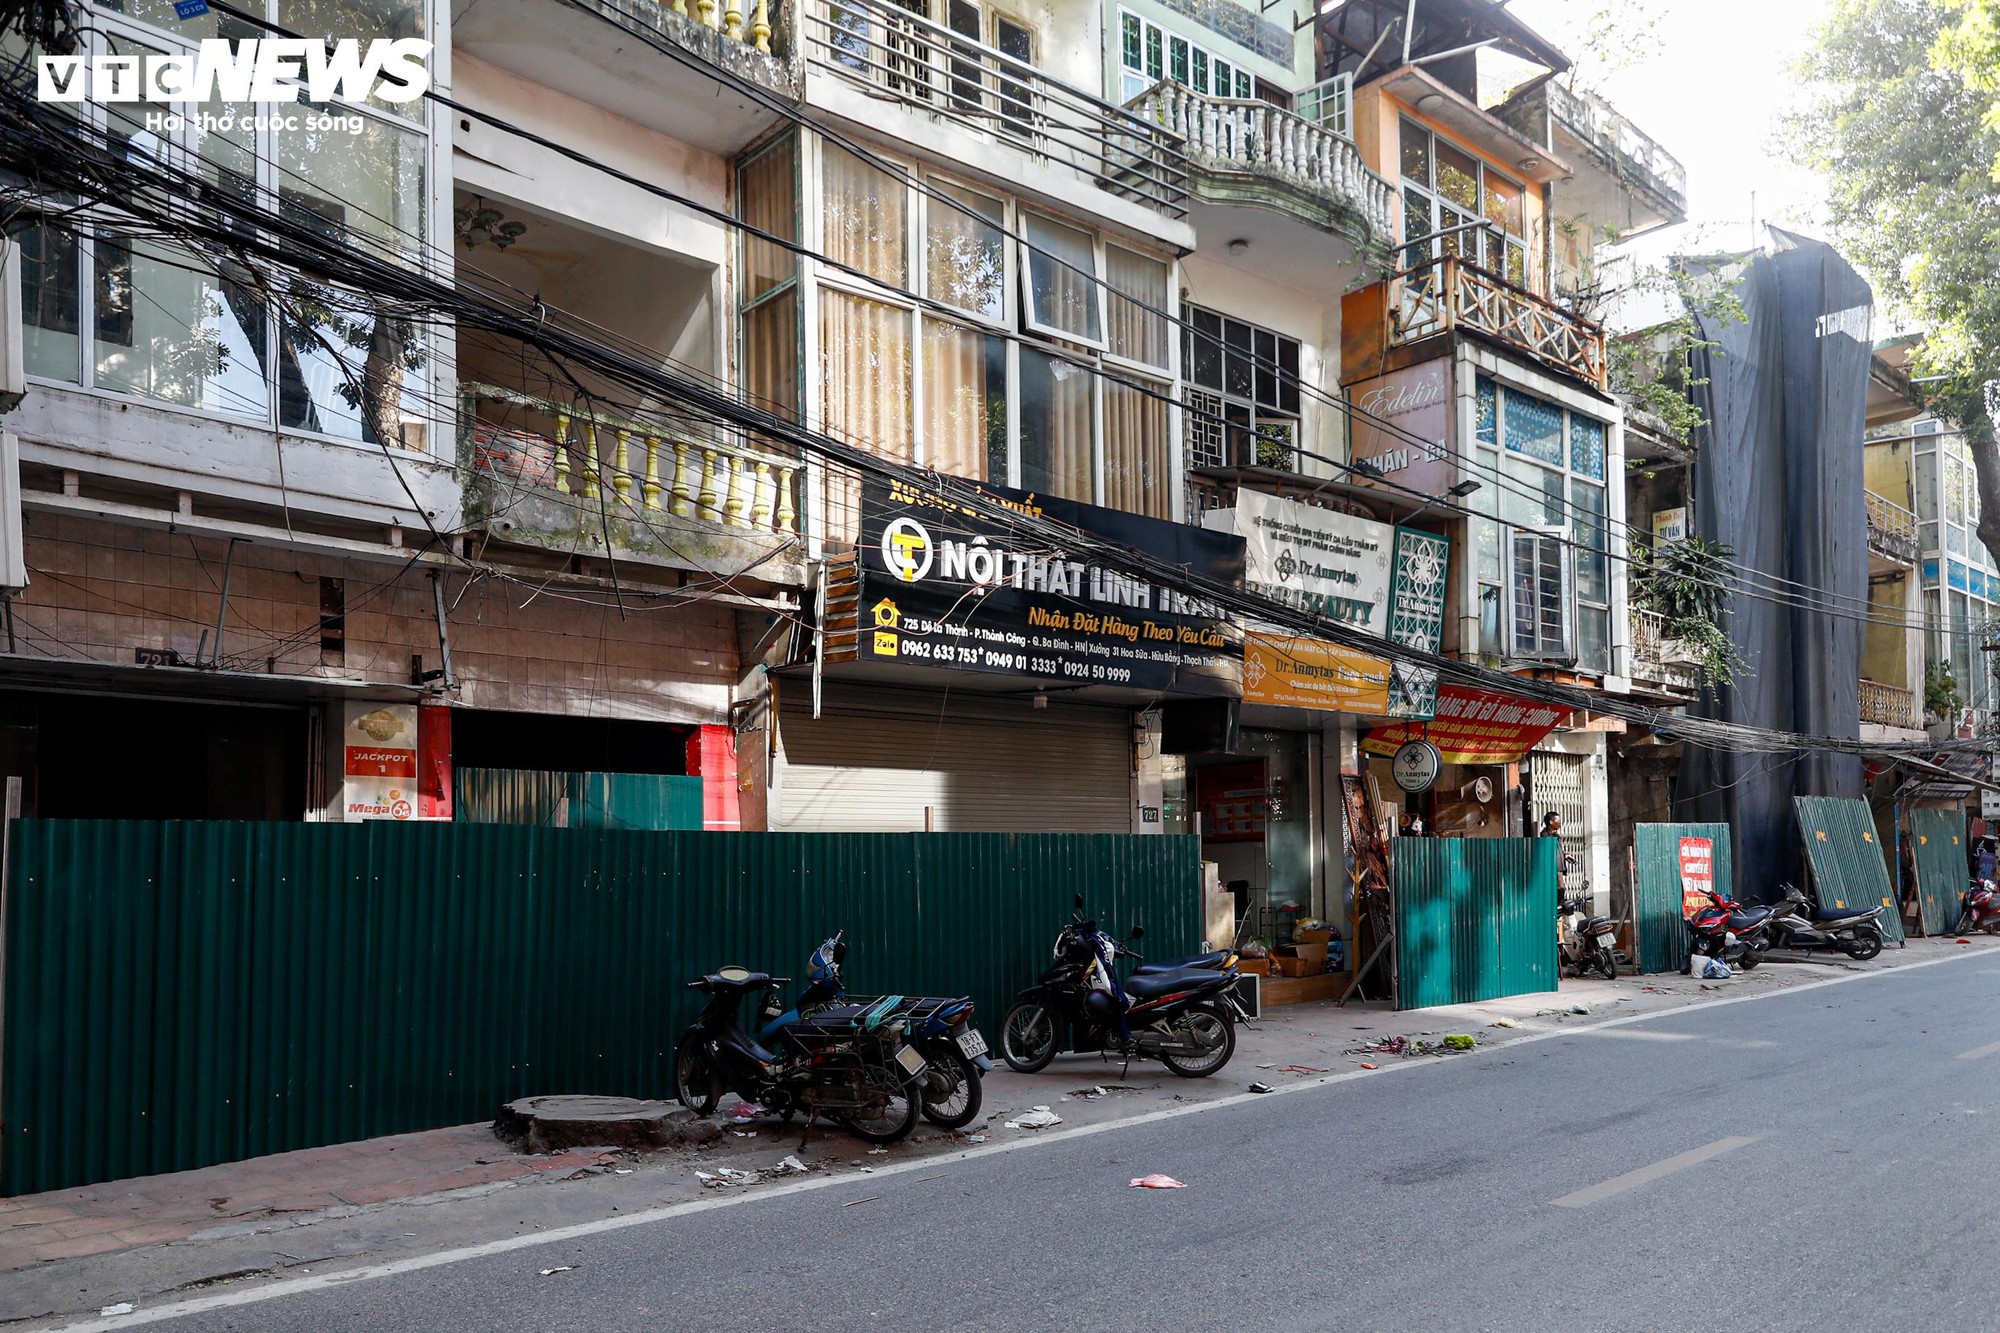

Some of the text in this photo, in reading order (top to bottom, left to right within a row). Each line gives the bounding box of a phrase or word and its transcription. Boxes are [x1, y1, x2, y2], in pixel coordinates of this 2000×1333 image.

[941, 535, 1004, 596] NỘI
[903, 617, 919, 631] 725
[945, 623, 969, 637] Thành
[1005, 632, 1026, 647] Công
[1053, 637, 1070, 651] Đình
[1112, 646, 1120, 657] 31
[1120, 647, 1134, 658] Hoa
[1135, 649, 1148, 660] Sữa
[1151, 650, 1164, 661] Hữu
[1028, 606, 1225, 648] Nhận Đặt Hàng Theo Yêu Cầu
[876, 637, 895, 649] Zalo
[901, 639, 931, 658] 0962
[933, 643, 955, 661] 633
[985, 651, 1012, 669] 0949
[1015, 656, 1027, 670] 01
[1064, 661, 1089, 678] 0924
[1092, 665, 1105, 680] 50
[1107, 667, 1131, 683] 9999
[354, 753, 408, 762] JACKPOT
[348, 803, 390, 815] Mega
[1143, 808, 1158, 821] 727
